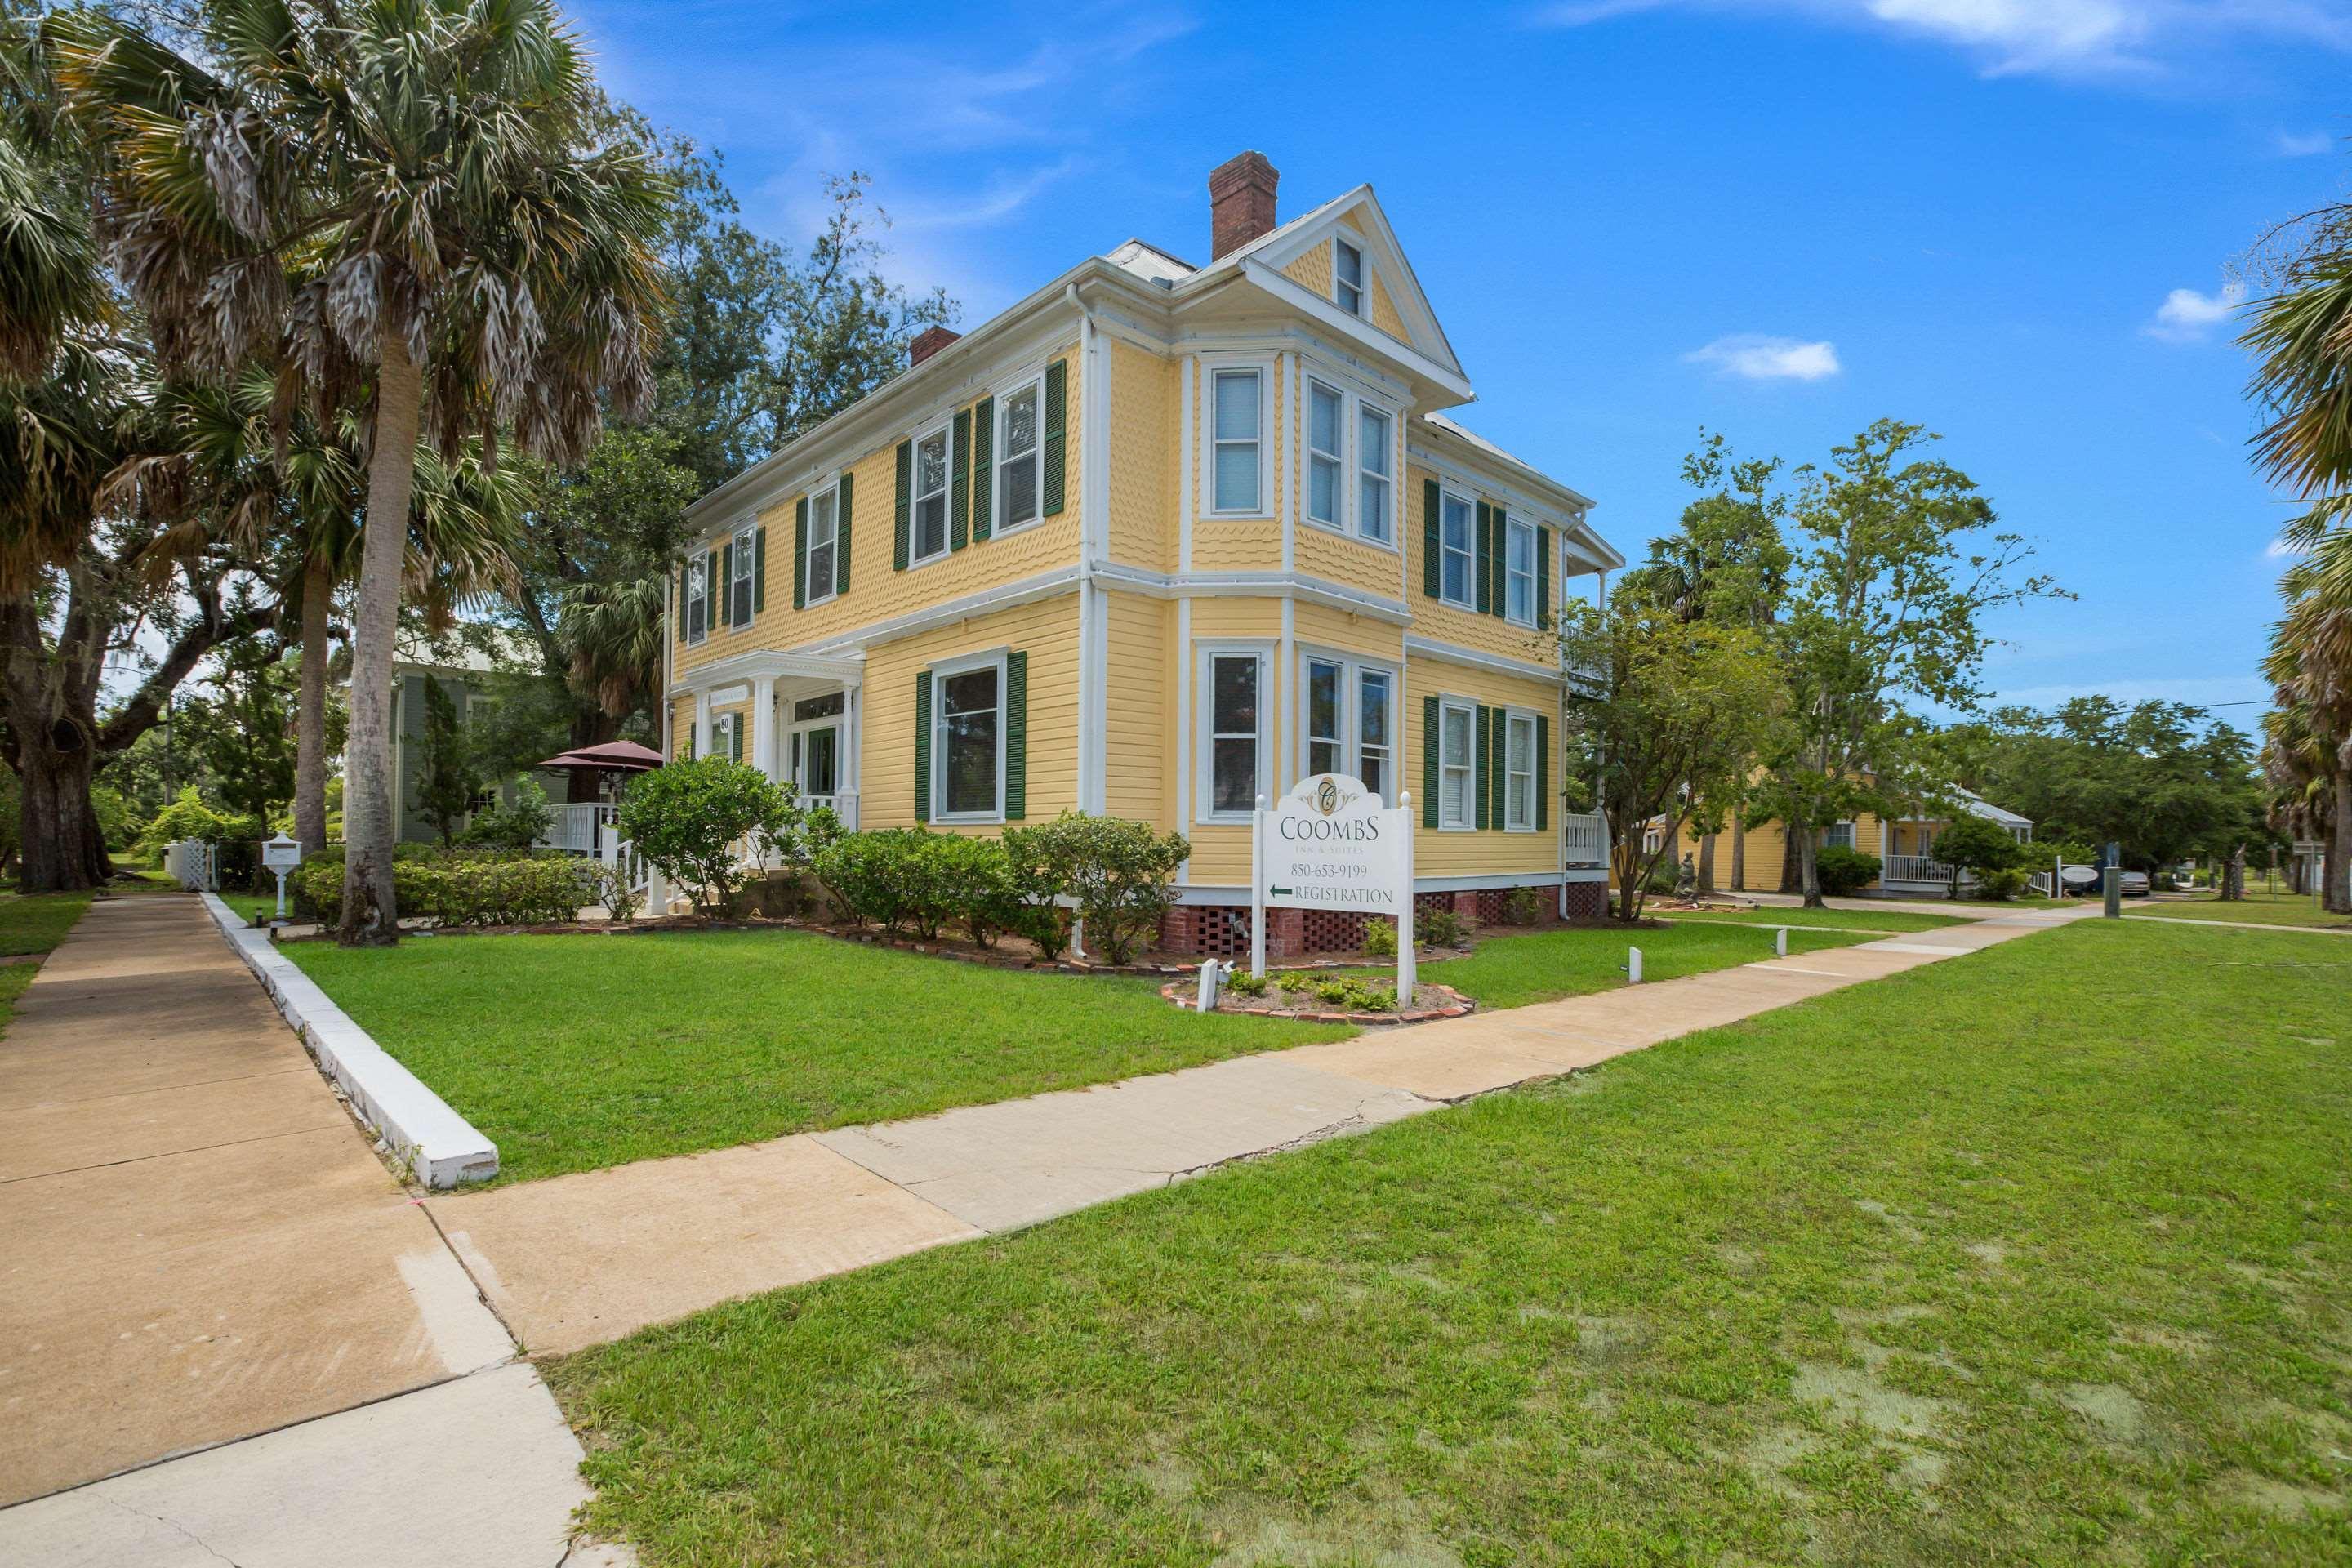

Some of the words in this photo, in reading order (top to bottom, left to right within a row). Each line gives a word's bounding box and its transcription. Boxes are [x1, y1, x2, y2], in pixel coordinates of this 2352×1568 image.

[1281, 816, 1379, 841] COOMBS
[1290, 863, 1367, 879] 850-653-9199
[1295, 885, 1392, 903] REGISTRATION
